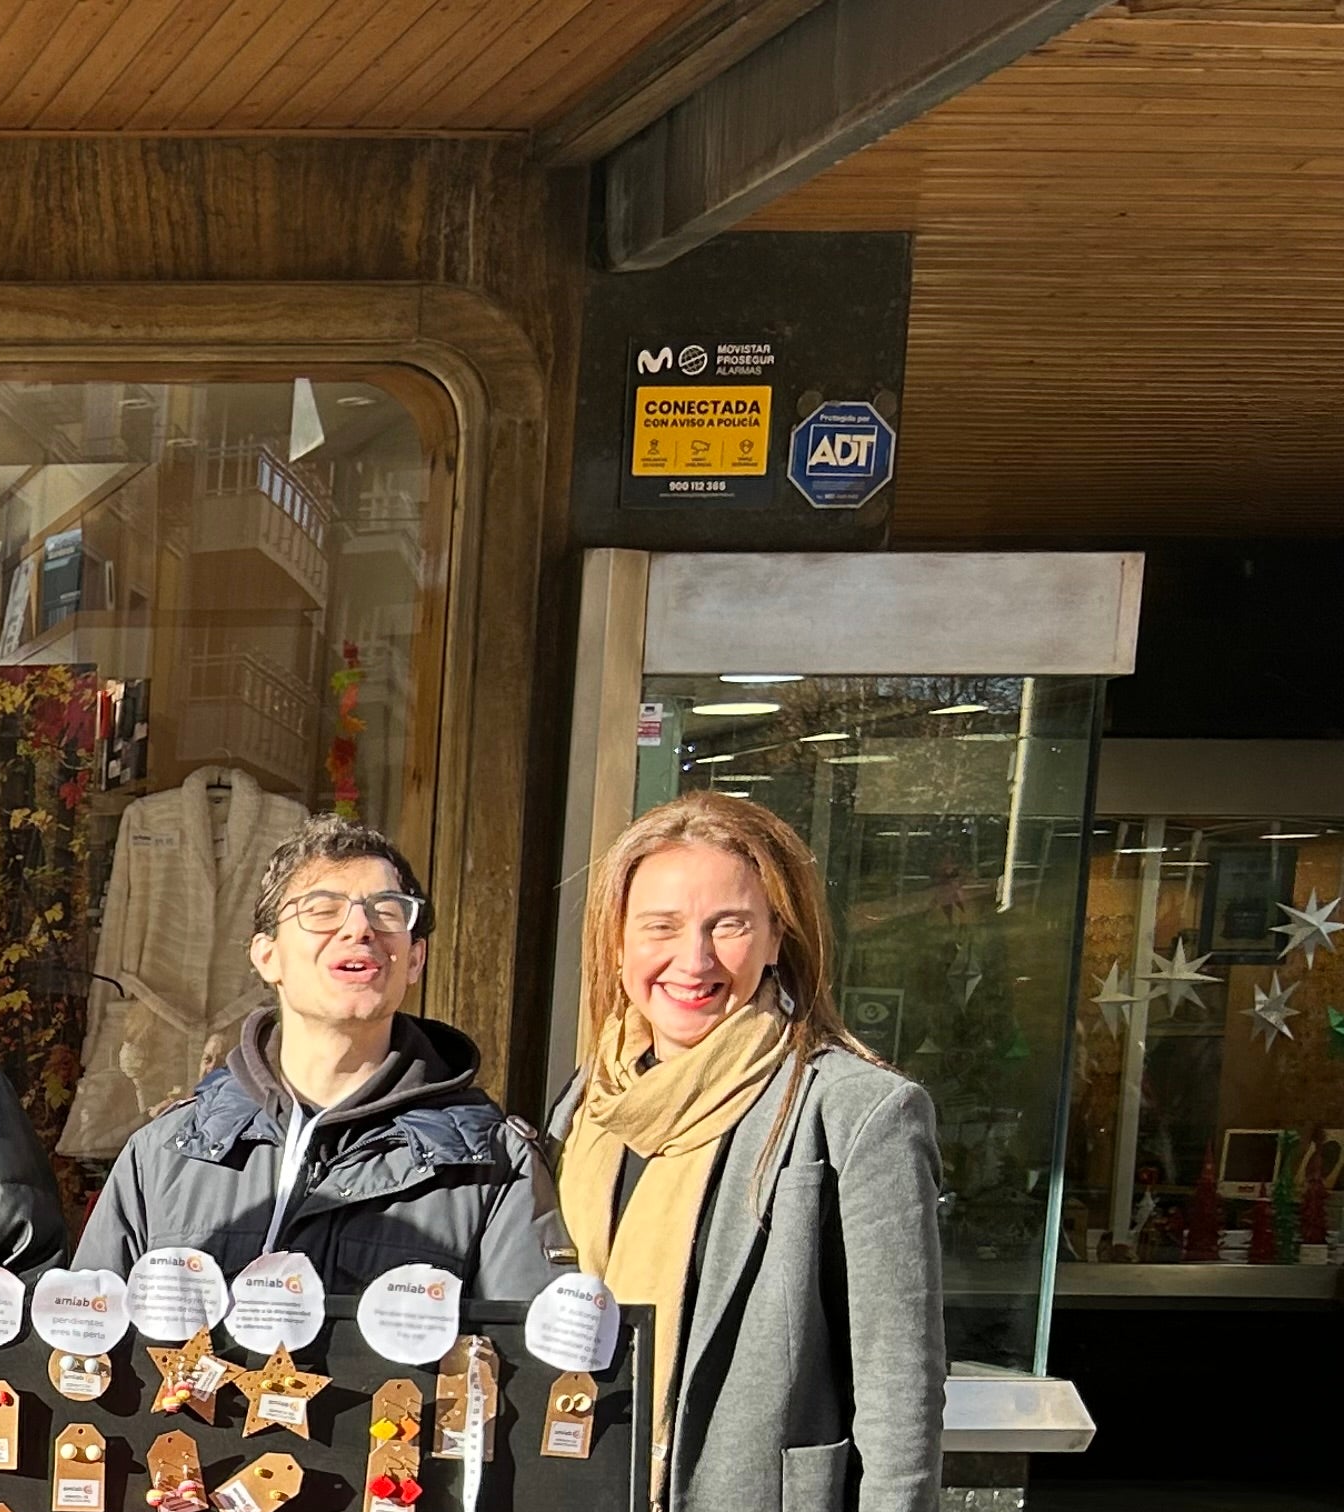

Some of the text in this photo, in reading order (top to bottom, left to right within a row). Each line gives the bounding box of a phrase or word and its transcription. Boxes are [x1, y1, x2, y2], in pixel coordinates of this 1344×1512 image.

[717, 344, 771, 354] MOVISTAR
[716, 355, 775, 365] PROSEGUR
[715, 366, 762, 375] ALARMAS
[644, 400, 761, 415] CONECTADA
[643, 416, 760, 428] CON AVISO A POLICÍA
[808, 433, 876, 467] ADT
[669, 481, 688, 491] 900
[691, 481, 705, 491] 112
[149, 1257, 186, 1267] amiab
[246, 1278, 284, 1289] amiab
[387, 1283, 426, 1295] amiab
[557, 1287, 594, 1302] amiab
[54, 1296, 90, 1308] amiab
